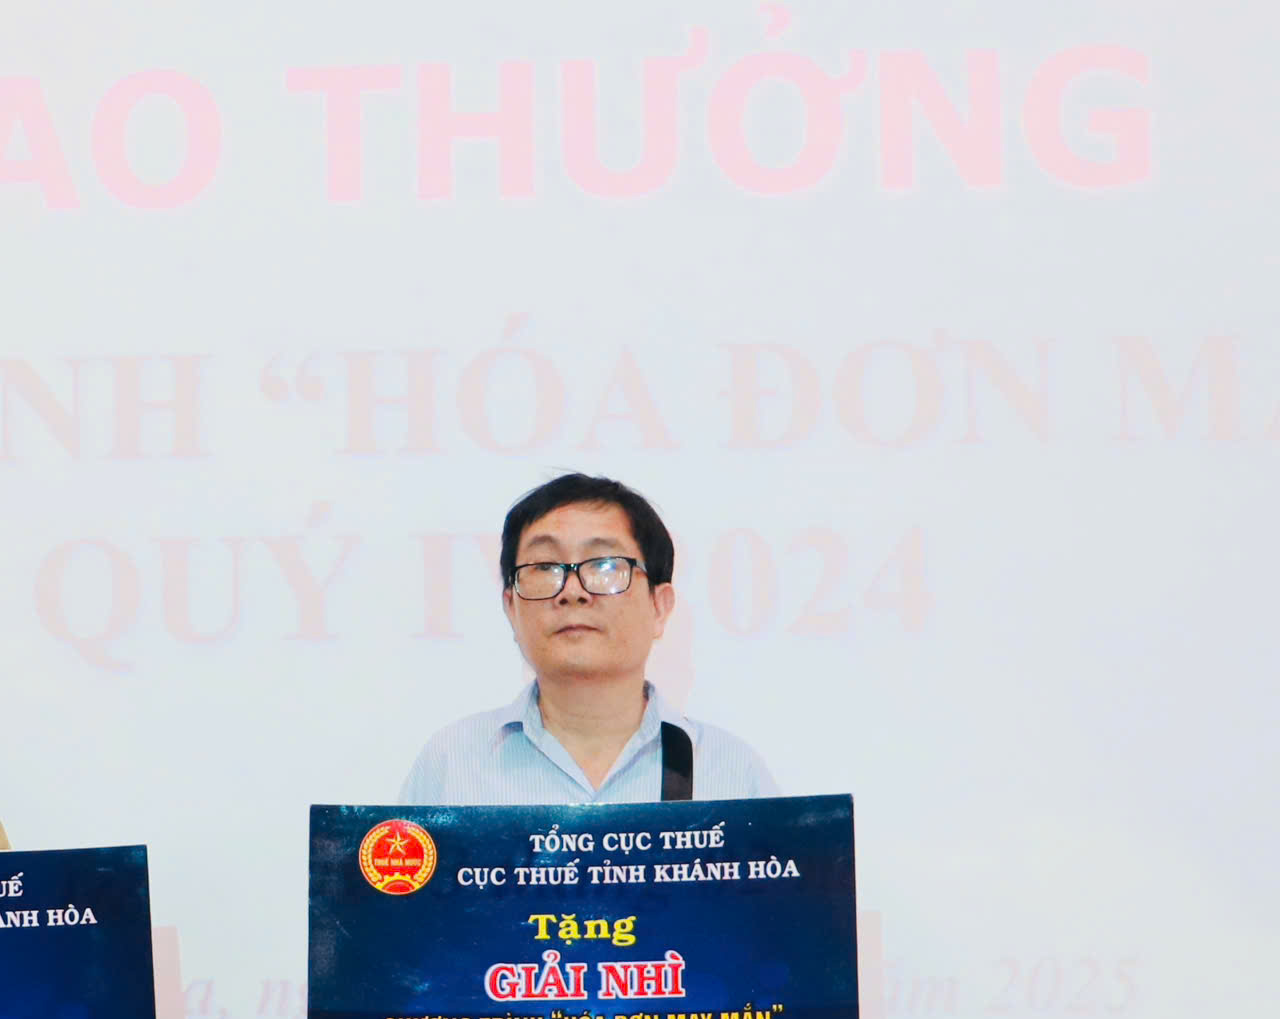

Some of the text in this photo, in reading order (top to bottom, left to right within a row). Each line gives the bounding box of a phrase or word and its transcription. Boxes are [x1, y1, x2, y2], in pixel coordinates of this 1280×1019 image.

[286, 3, 1152, 202] THƯỞNG
[712, 327, 1059, 450] ĐƠN
[1110, 333, 1280, 442] M
[33, 499, 363, 674] QUÝ
[675, 522, 937, 640] 024
[530, 821, 726, 856] TỔNG CỤC THUẾ
[457, 856, 800, 890] CỤC THUẾ TỈNH KHÁNH HÒA
[46, 904, 98, 928] HÒA
[527, 912, 637, 946] Tặng
[484, 949, 687, 1001] GIẢI NHÌ
[983, 954, 1145, 1017] 2025
